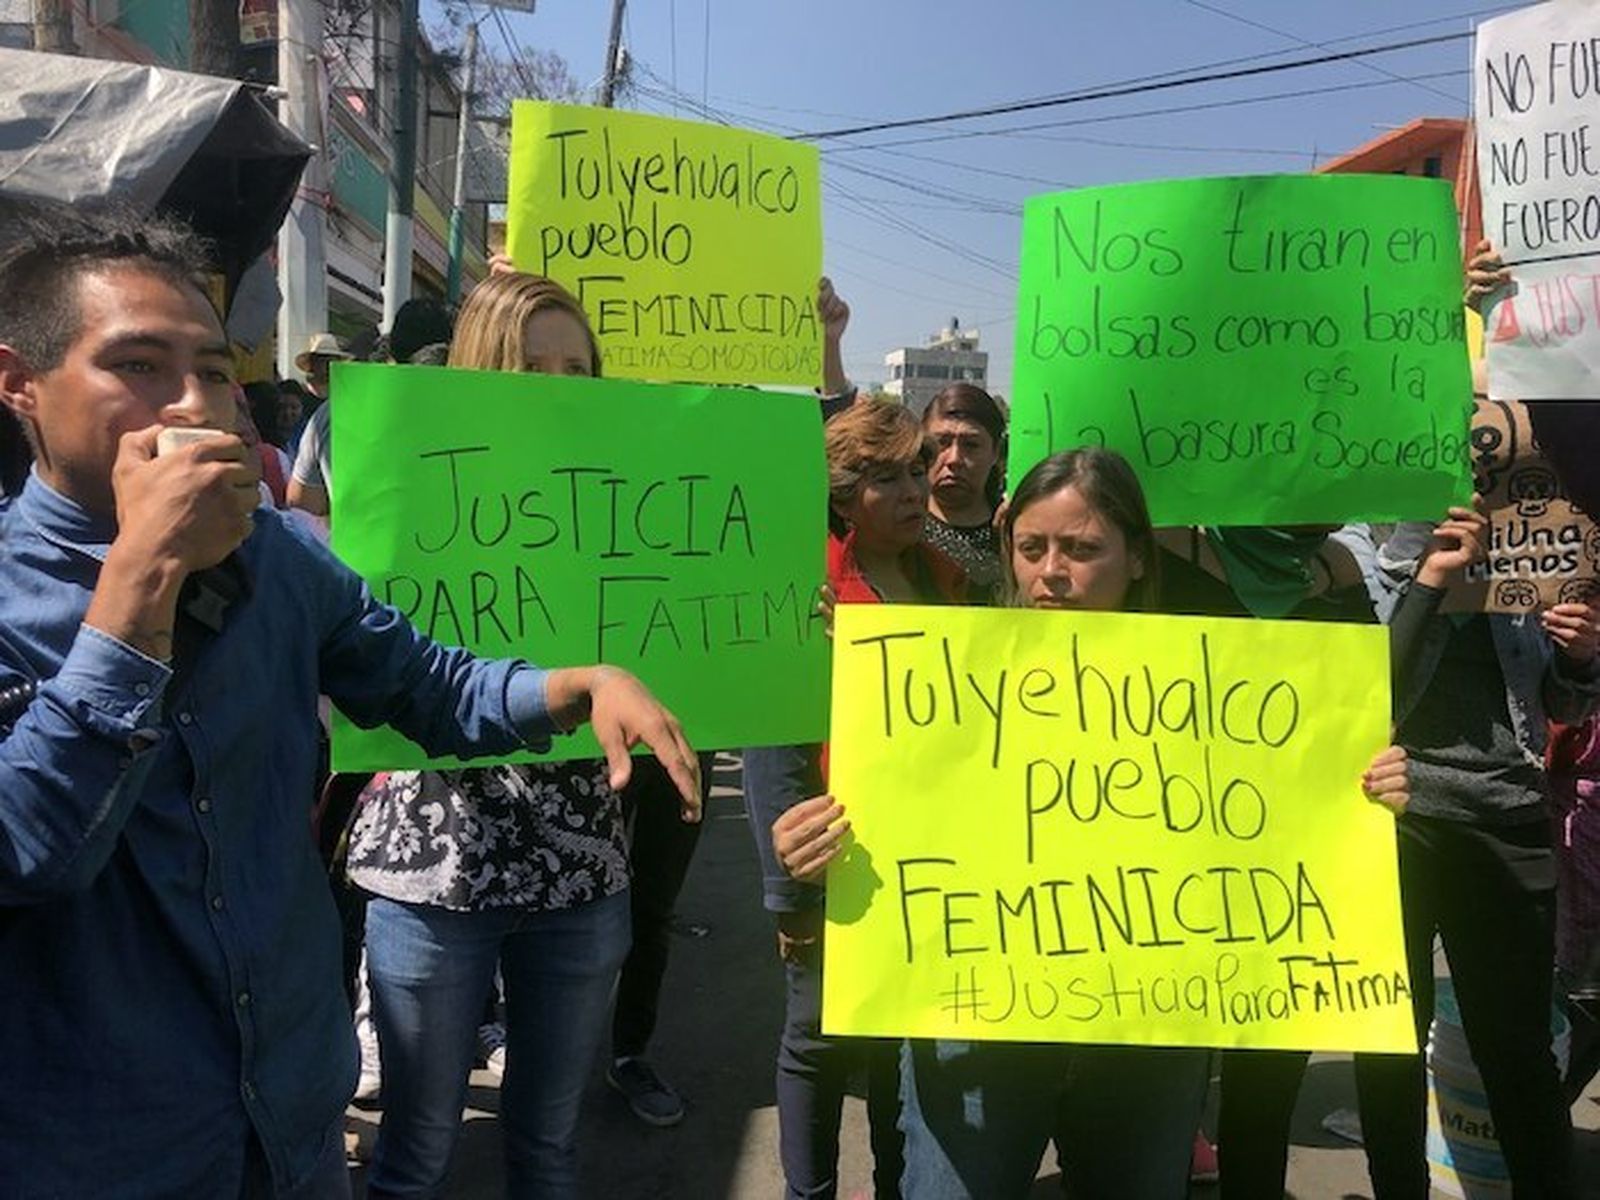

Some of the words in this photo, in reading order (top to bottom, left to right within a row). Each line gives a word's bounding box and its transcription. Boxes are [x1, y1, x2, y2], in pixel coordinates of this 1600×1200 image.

[1486, 52, 1534, 117] NO
[546, 126, 799, 223] Tulyehualco
[1492, 138, 1529, 187] NO
[1544, 125, 1600, 181] FUE
[541, 201, 692, 278] pueblo
[1054, 200, 1183, 278] Nos
[1225, 190, 1370, 274] tiran
[1387, 228, 1436, 264] en
[578, 275, 818, 342] FEMINICIDA
[1031, 285, 1196, 361] bolsas
[1214, 314, 1340, 354] como
[1304, 365, 1359, 397] es
[1391, 354, 1426, 402] la
[1129, 389, 1295, 469] basura
[414, 446, 755, 558] JUSTICIA
[386, 565, 557, 647] PARA
[851, 631, 1300, 769] Tulyehualco
[1026, 742, 1267, 864] pueblo
[896, 857, 1336, 964] FEMINICIDA
